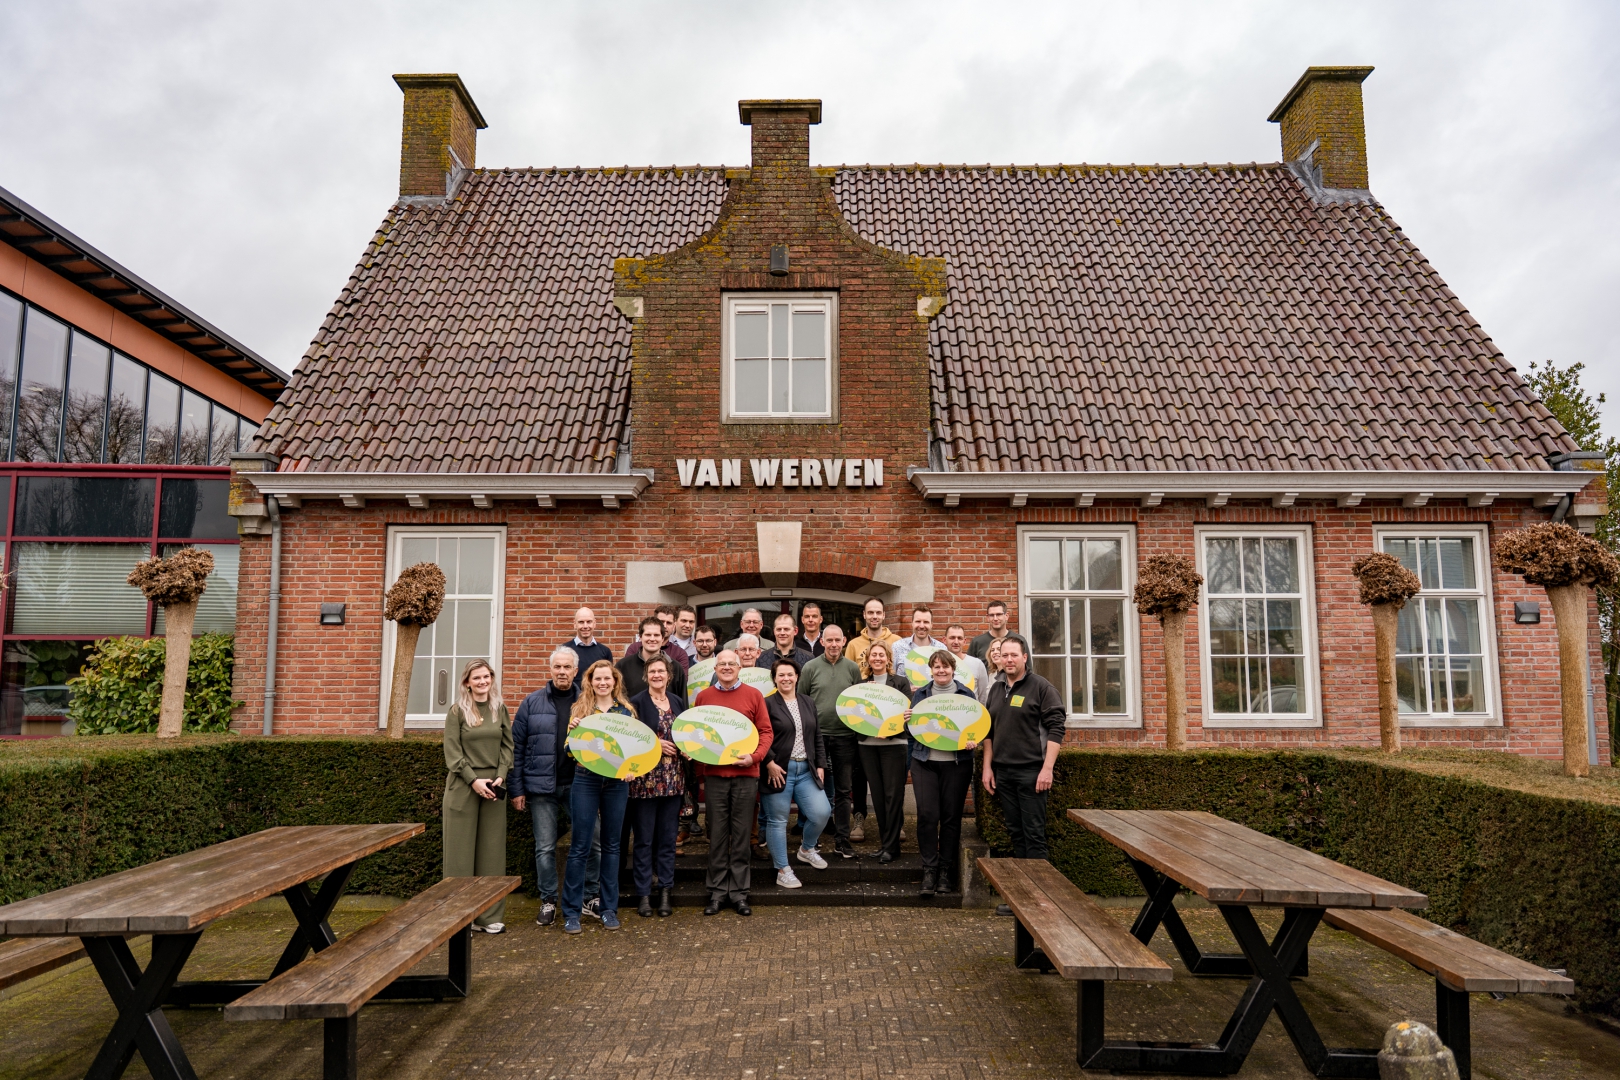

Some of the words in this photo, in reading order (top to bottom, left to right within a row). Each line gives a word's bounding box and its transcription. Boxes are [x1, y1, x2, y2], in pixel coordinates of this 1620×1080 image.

[676, 458, 741, 487] VAN
[750, 458, 884, 487] WERVEN
[865, 692, 904, 706] onbetaalbaar
[935, 703, 978, 714] onbetaalbaar
[612, 717, 624, 725] inzet
[704, 715, 747, 731] onbetaalbaar
[605, 724, 651, 744] onbetaalbaar
